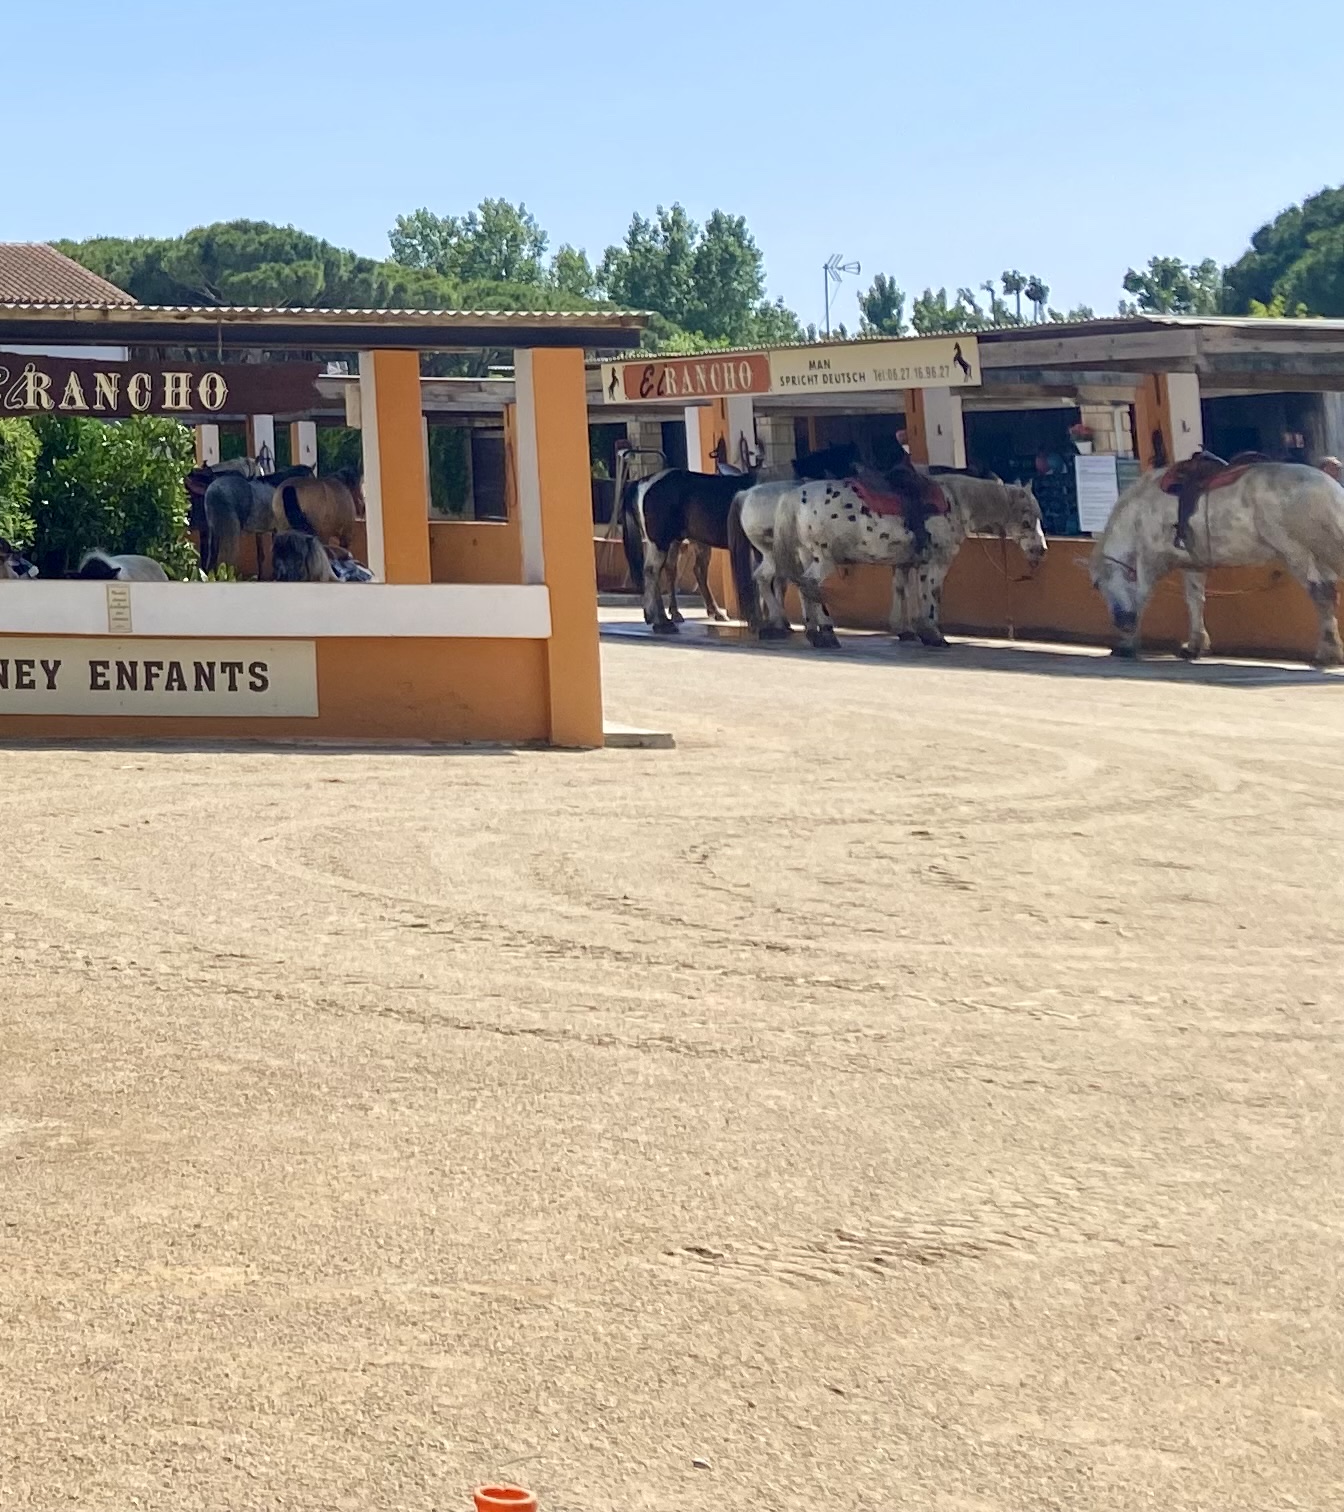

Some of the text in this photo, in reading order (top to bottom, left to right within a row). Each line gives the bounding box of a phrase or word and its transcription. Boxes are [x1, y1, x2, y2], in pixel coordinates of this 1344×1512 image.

[664, 360, 753, 395] RANCHO
[779, 373, 819, 386] SPRICHT
[822, 371, 866, 385] DEUTSCH
[808, 359, 831, 371] MAN
[23, 371, 229, 411] RANCHO
[88, 660, 269, 693] ENFANTS
